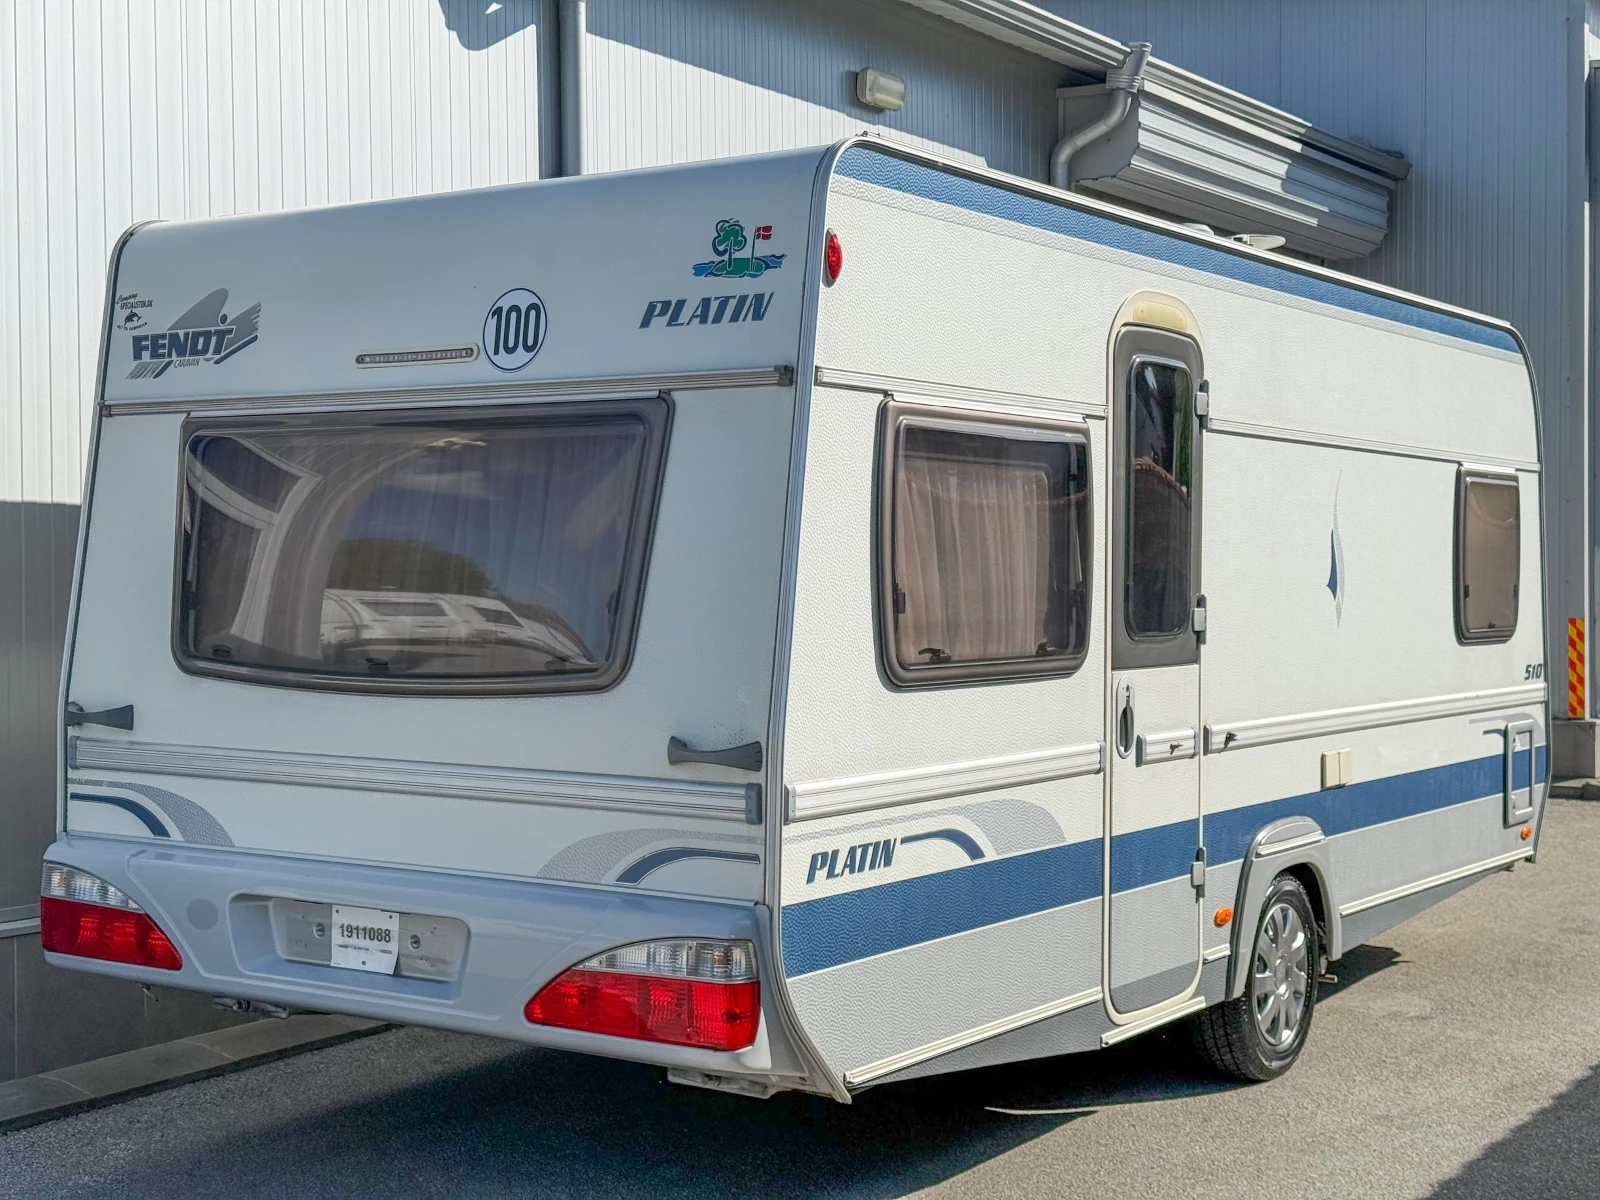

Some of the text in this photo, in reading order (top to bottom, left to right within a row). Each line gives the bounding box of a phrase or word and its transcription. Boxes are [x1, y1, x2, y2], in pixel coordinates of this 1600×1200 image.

[638, 291, 775, 329] PLATIN
[132, 327, 235, 361] FENDT
[491, 302, 542, 356] 100
[173, 358, 200, 368] CARAVAN
[1523, 663, 1543, 681] 510
[806, 838, 898, 885] PLATIN
[339, 923, 391, 943] 1911088
